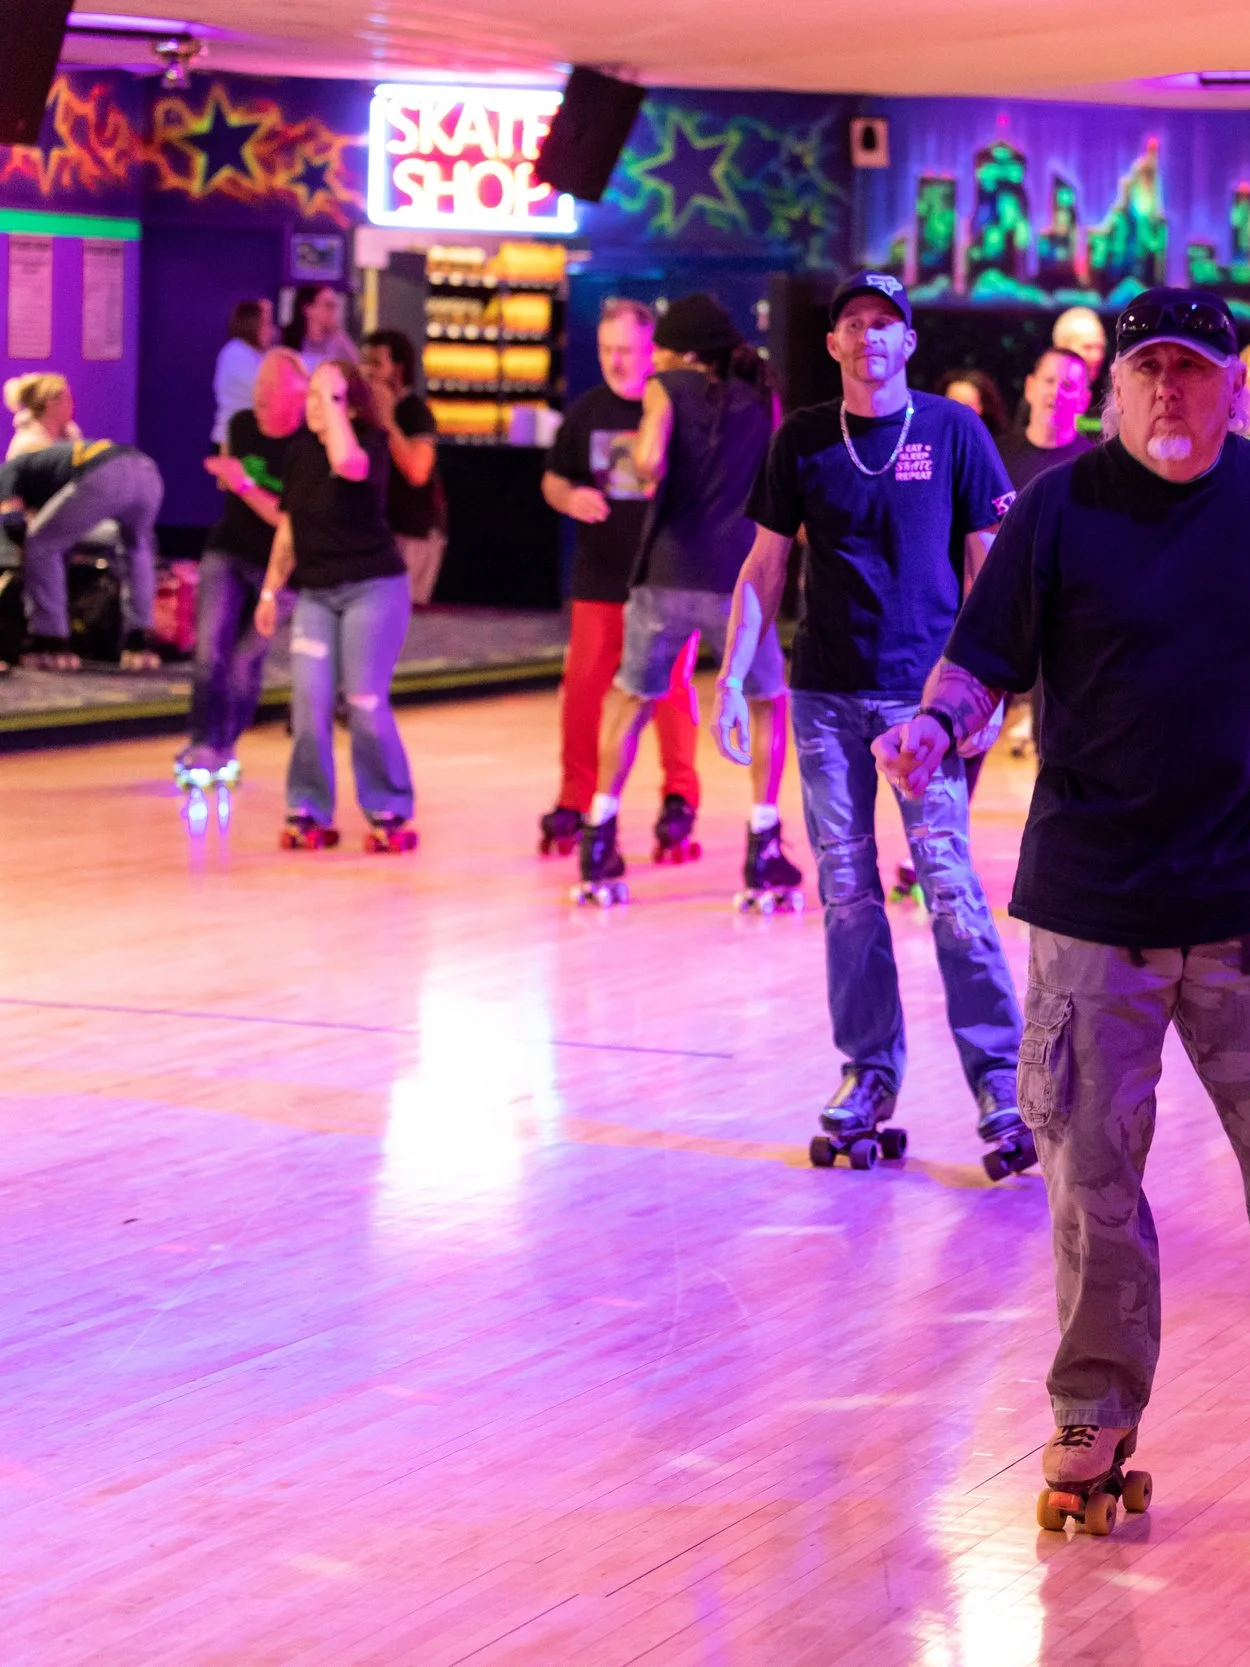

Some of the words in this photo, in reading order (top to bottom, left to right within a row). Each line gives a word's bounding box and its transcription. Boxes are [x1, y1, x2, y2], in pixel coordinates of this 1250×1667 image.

[393, 157, 552, 221] SHOP
[905, 443, 923, 453] EAT
[898, 452, 930, 461] SLEEP
[896, 460, 932, 471] SKATE
[895, 471, 932, 481] REPEAT
